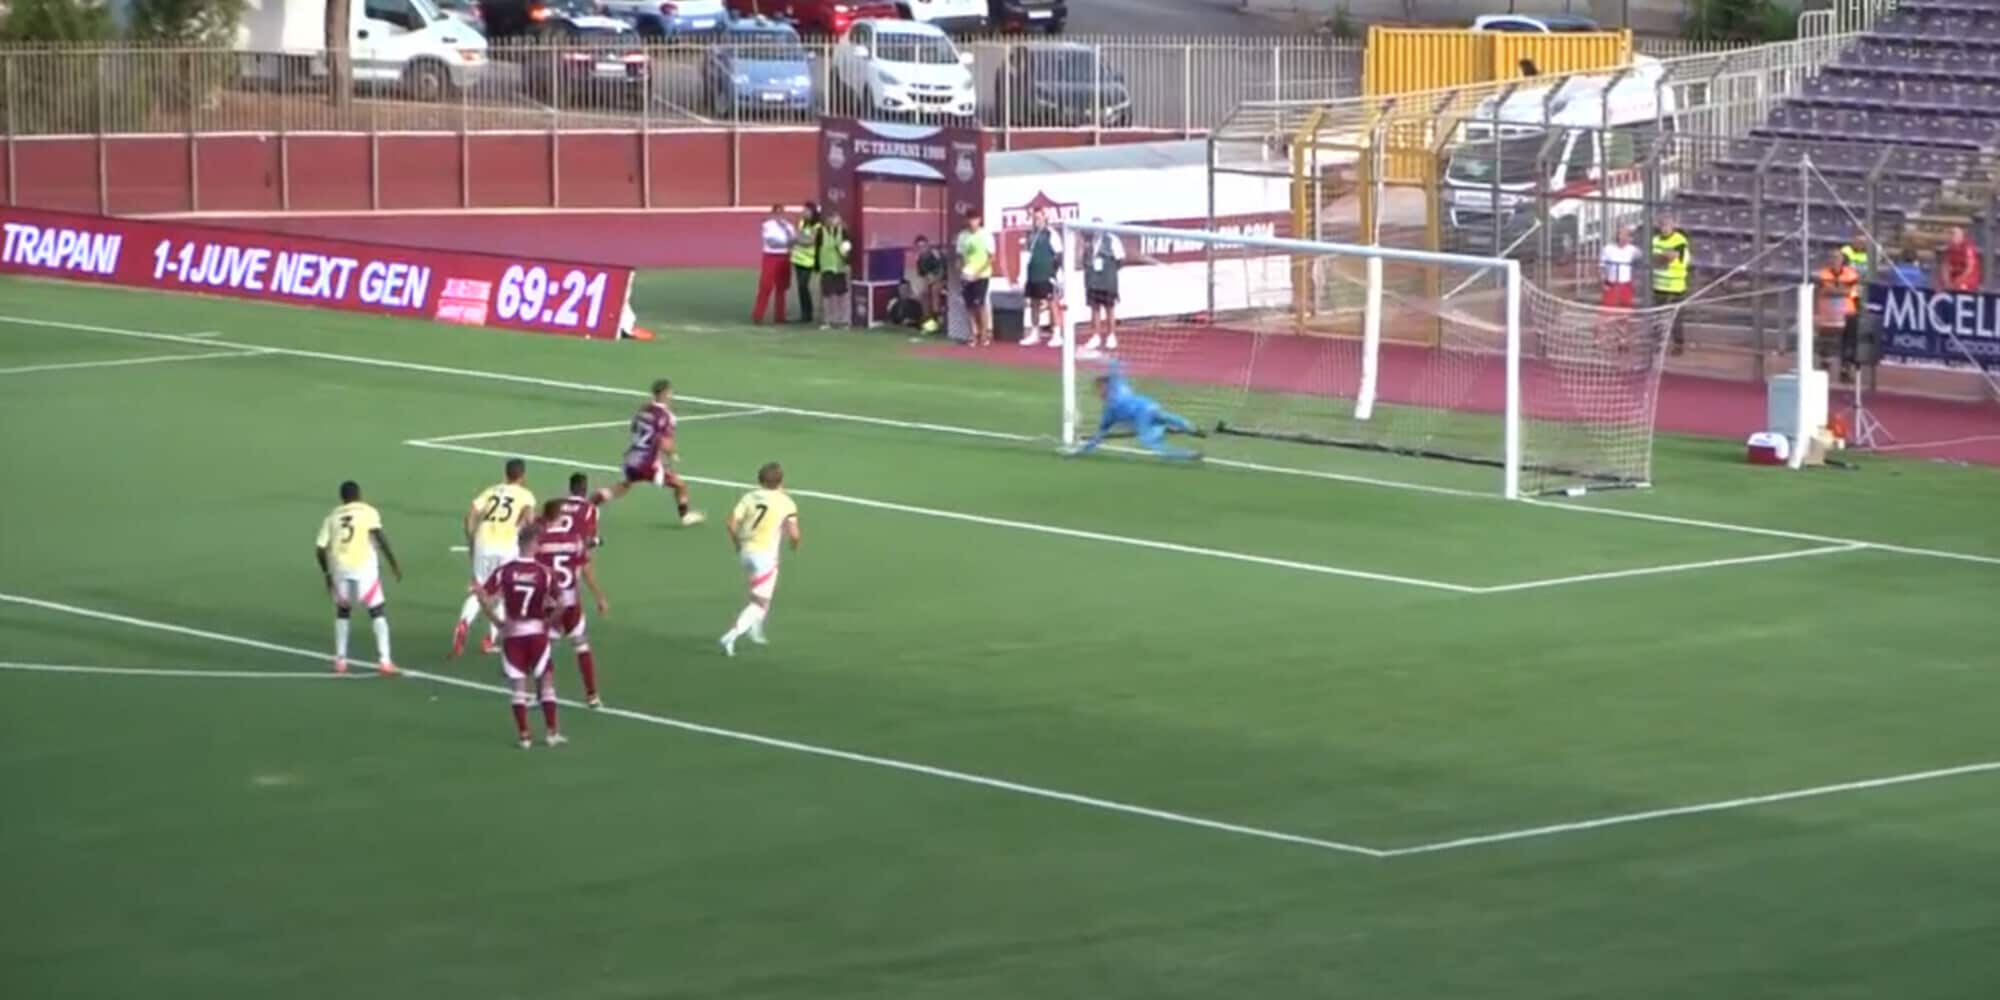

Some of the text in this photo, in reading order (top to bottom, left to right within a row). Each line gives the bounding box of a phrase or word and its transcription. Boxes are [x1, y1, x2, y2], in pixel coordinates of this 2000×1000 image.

[1003, 204, 1078, 229] TRAANI
[2, 223, 122, 274] TRAPANI
[270, 251, 359, 300] NEXT
[358, 260, 431, 309] GEN
[496, 264, 607, 328] 69:21
[484, 495, 515, 522] 23
[752, 503, 768, 530] 7
[340, 515, 354, 544] 3
[552, 554, 574, 588] 5
[513, 585, 536, 616] 7
